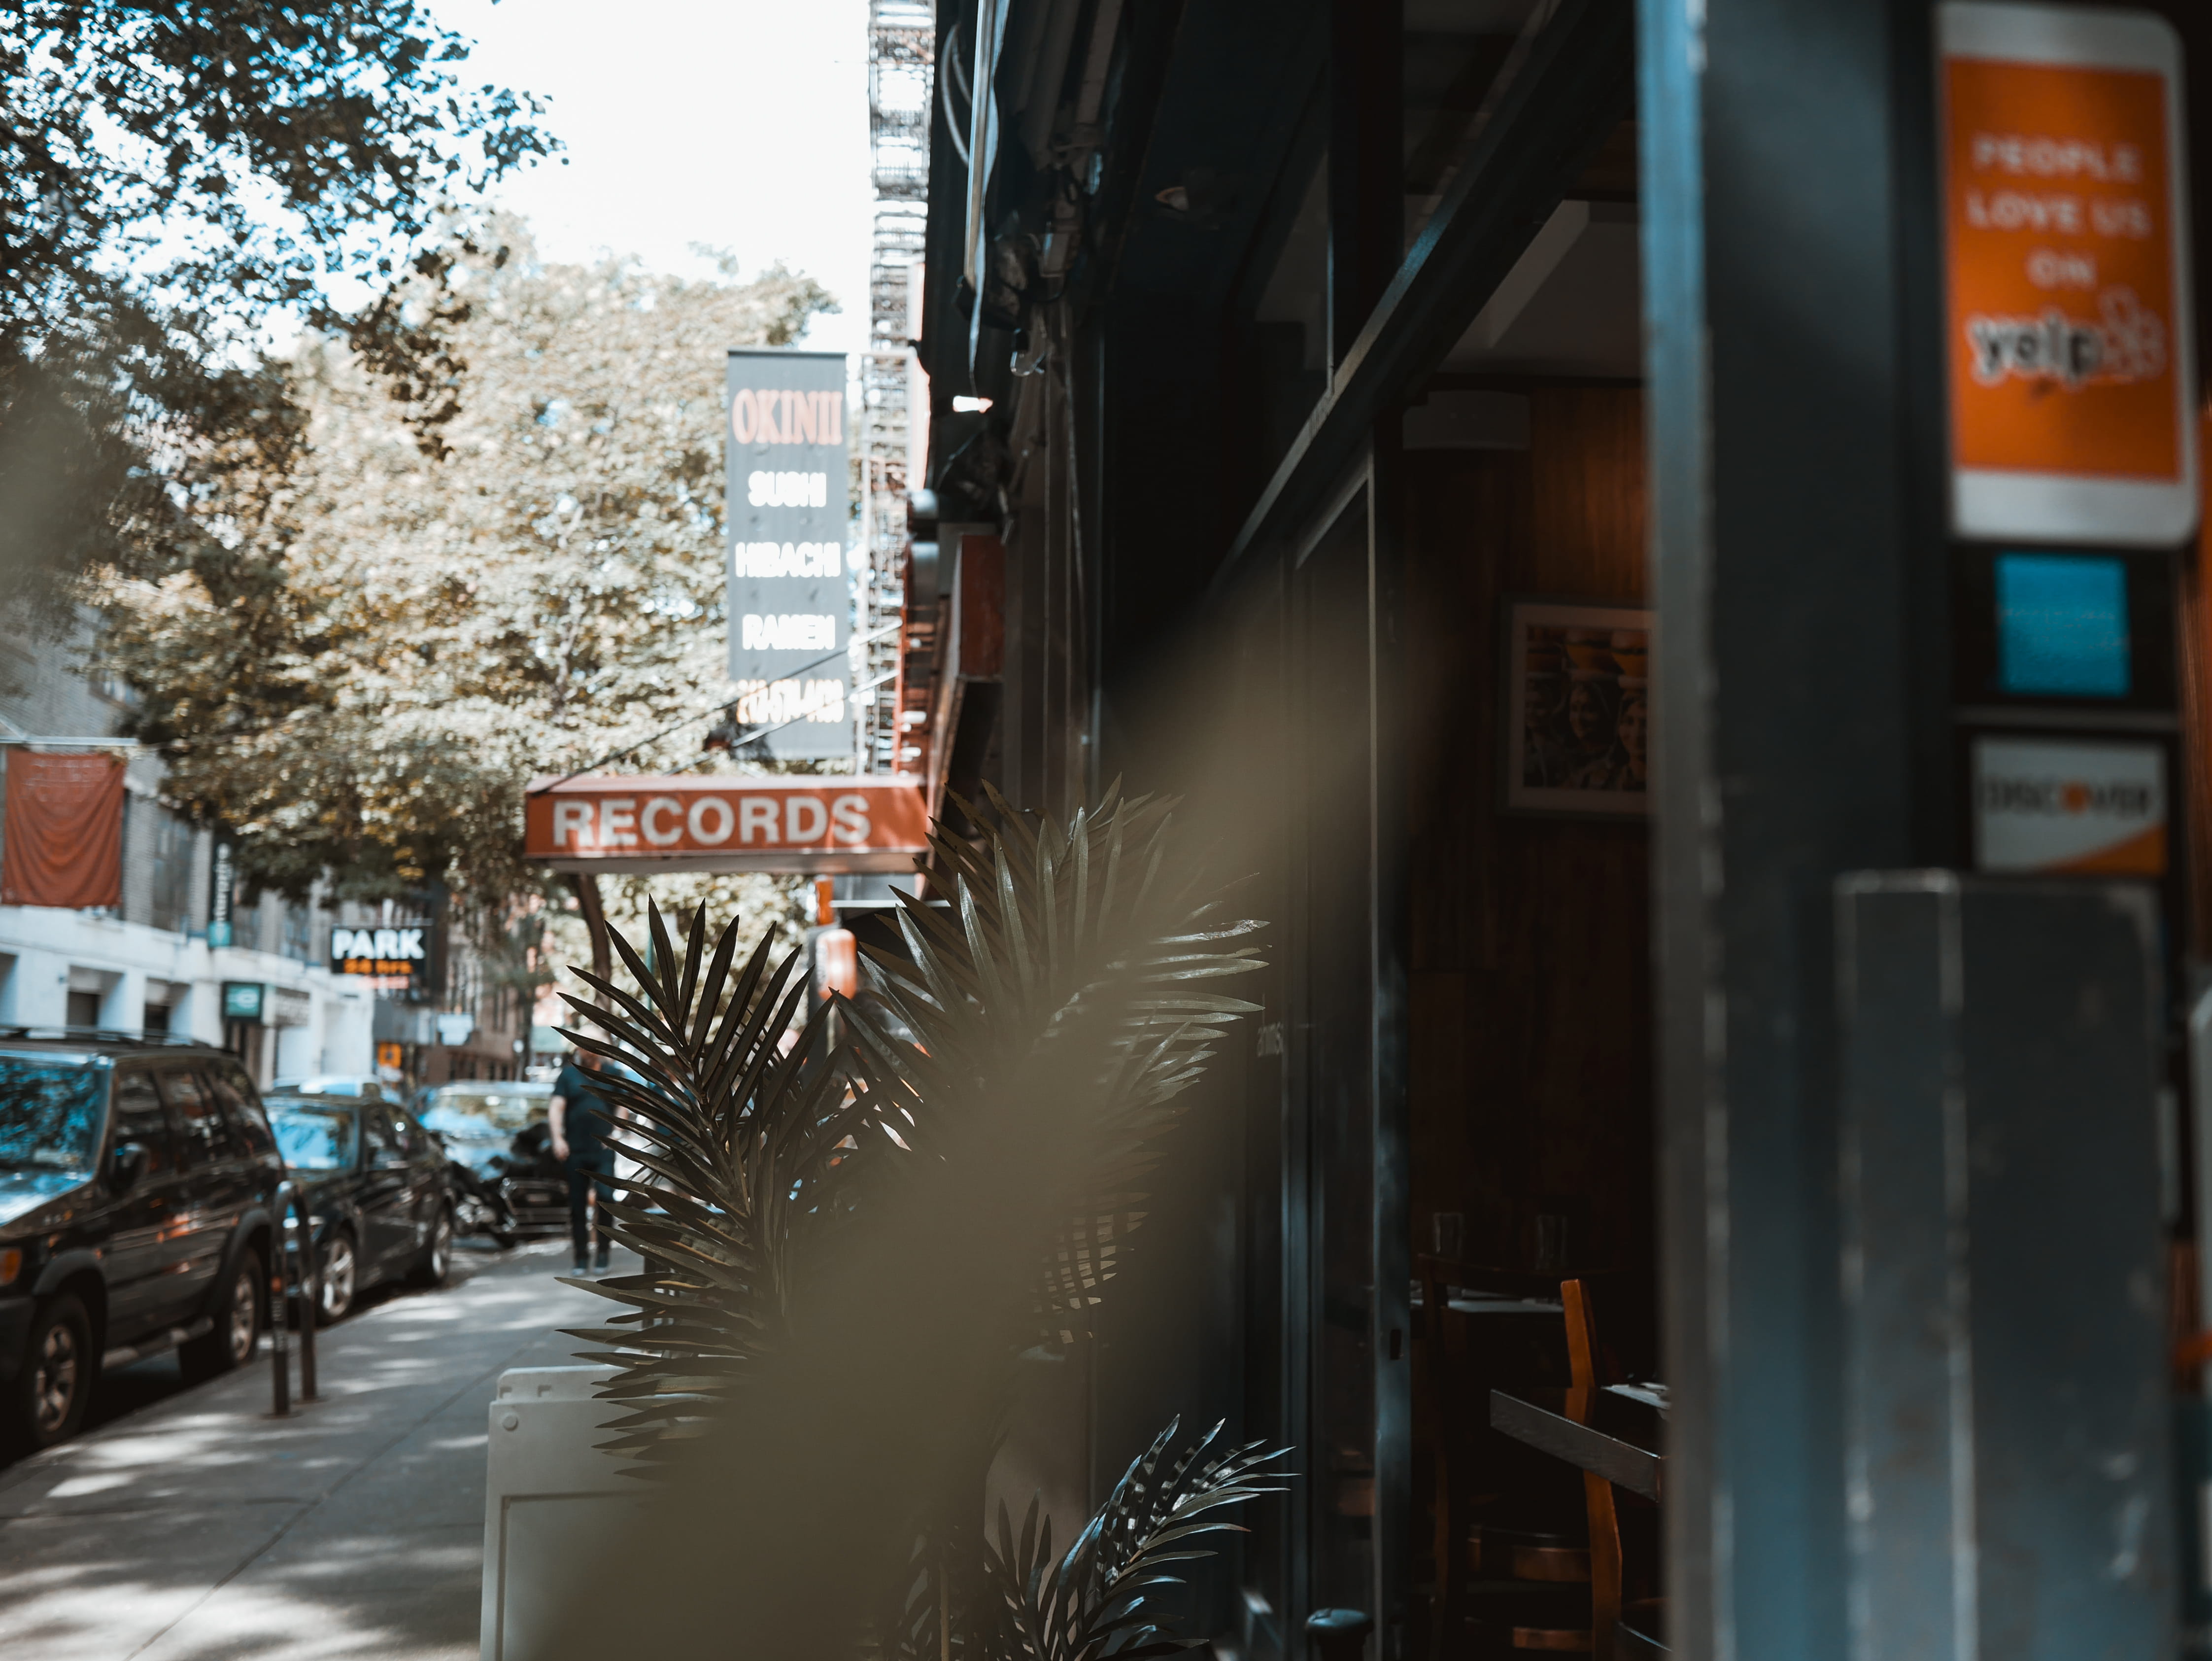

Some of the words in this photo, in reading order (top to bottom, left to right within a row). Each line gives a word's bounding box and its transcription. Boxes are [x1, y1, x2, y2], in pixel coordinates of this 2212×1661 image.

[1973, 135, 2141, 182] PEOPLE
[1968, 189, 2082, 234] LOVE
[2091, 199, 2151, 239] US
[2026, 250, 2095, 291] ON
[1969, 308, 2104, 389] yelp
[732, 388, 843, 445] OKINII
[748, 471, 827, 507] SUSHI
[736, 541, 841, 578] HIBACHI
[742, 614, 836, 650] RAMEN
[553, 794, 871, 846] RECORDS
[333, 929, 425, 959] PARK
